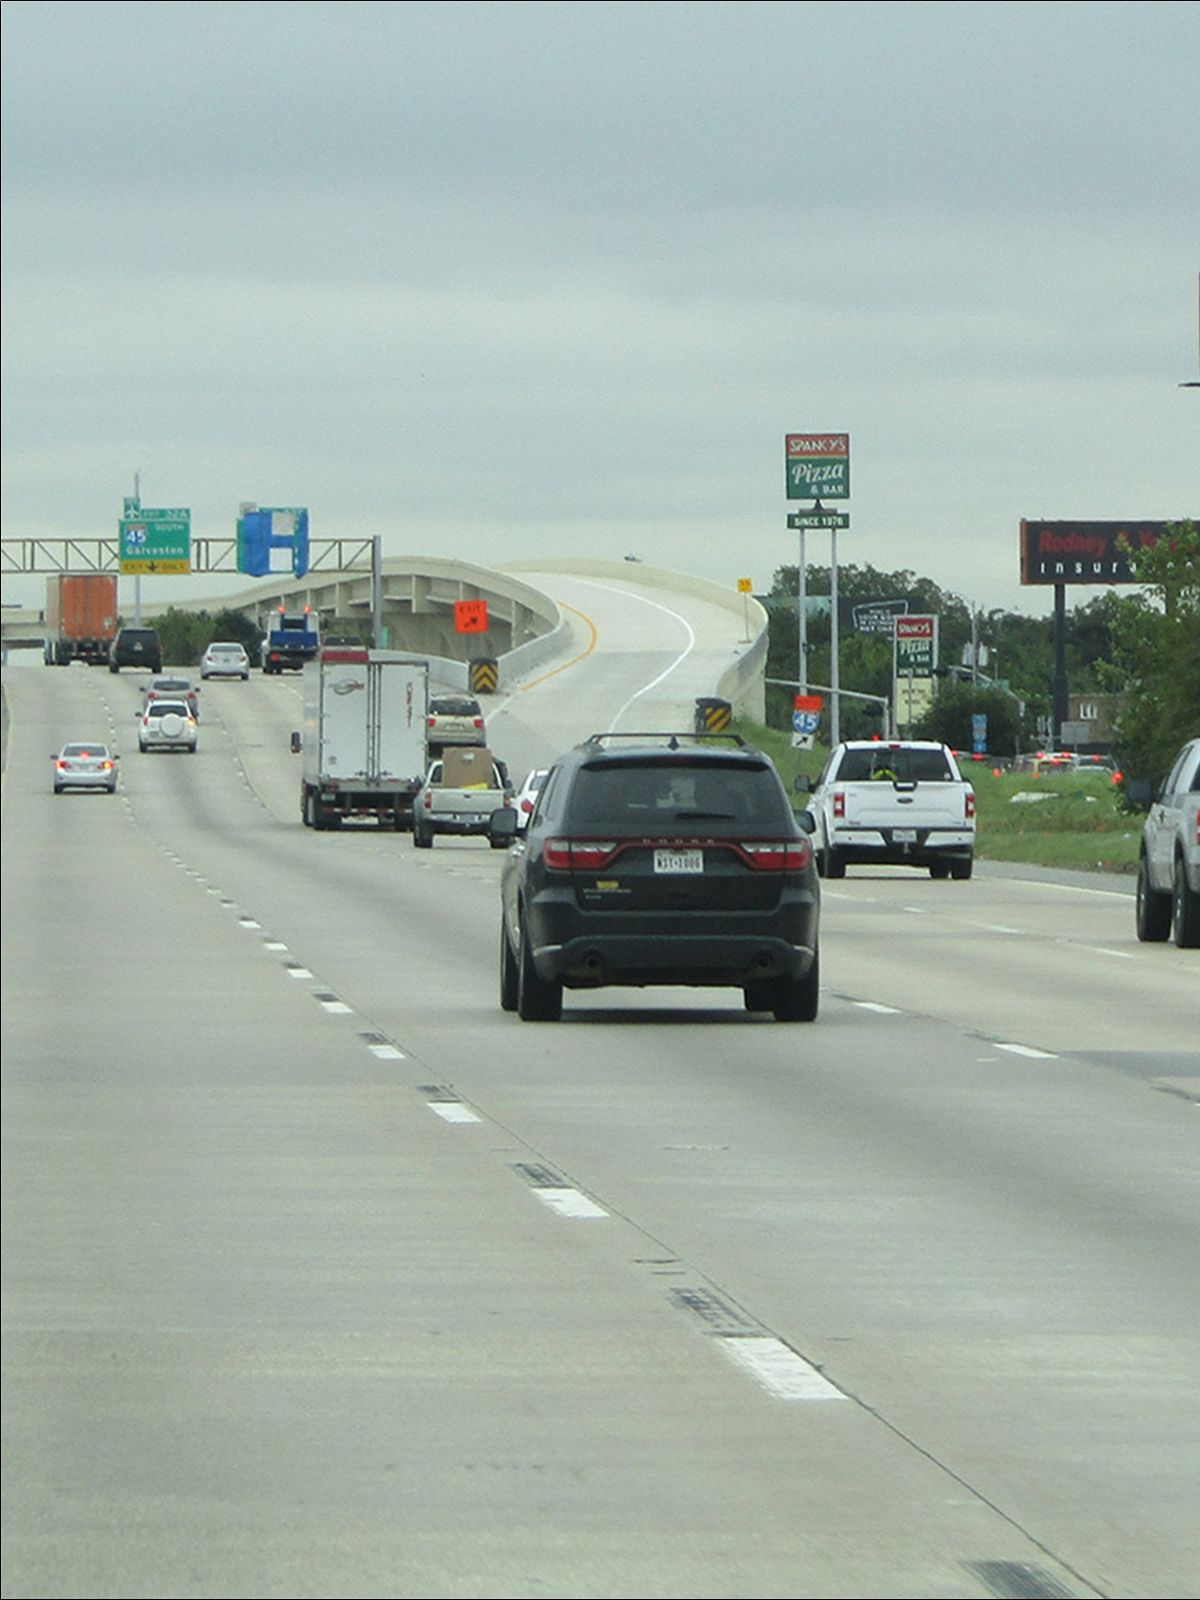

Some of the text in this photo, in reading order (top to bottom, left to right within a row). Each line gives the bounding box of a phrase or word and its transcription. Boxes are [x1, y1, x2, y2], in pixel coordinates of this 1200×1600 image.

[791, 463, 844, 484] Pizza
[810, 485, 844, 494] & BAR
[794, 517, 819, 526] SINCE
[126, 529, 146, 543] 45
[125, 545, 185, 555] Galveston
[1039, 530, 1106, 558] Rodney
[795, 712, 818, 729] 45
